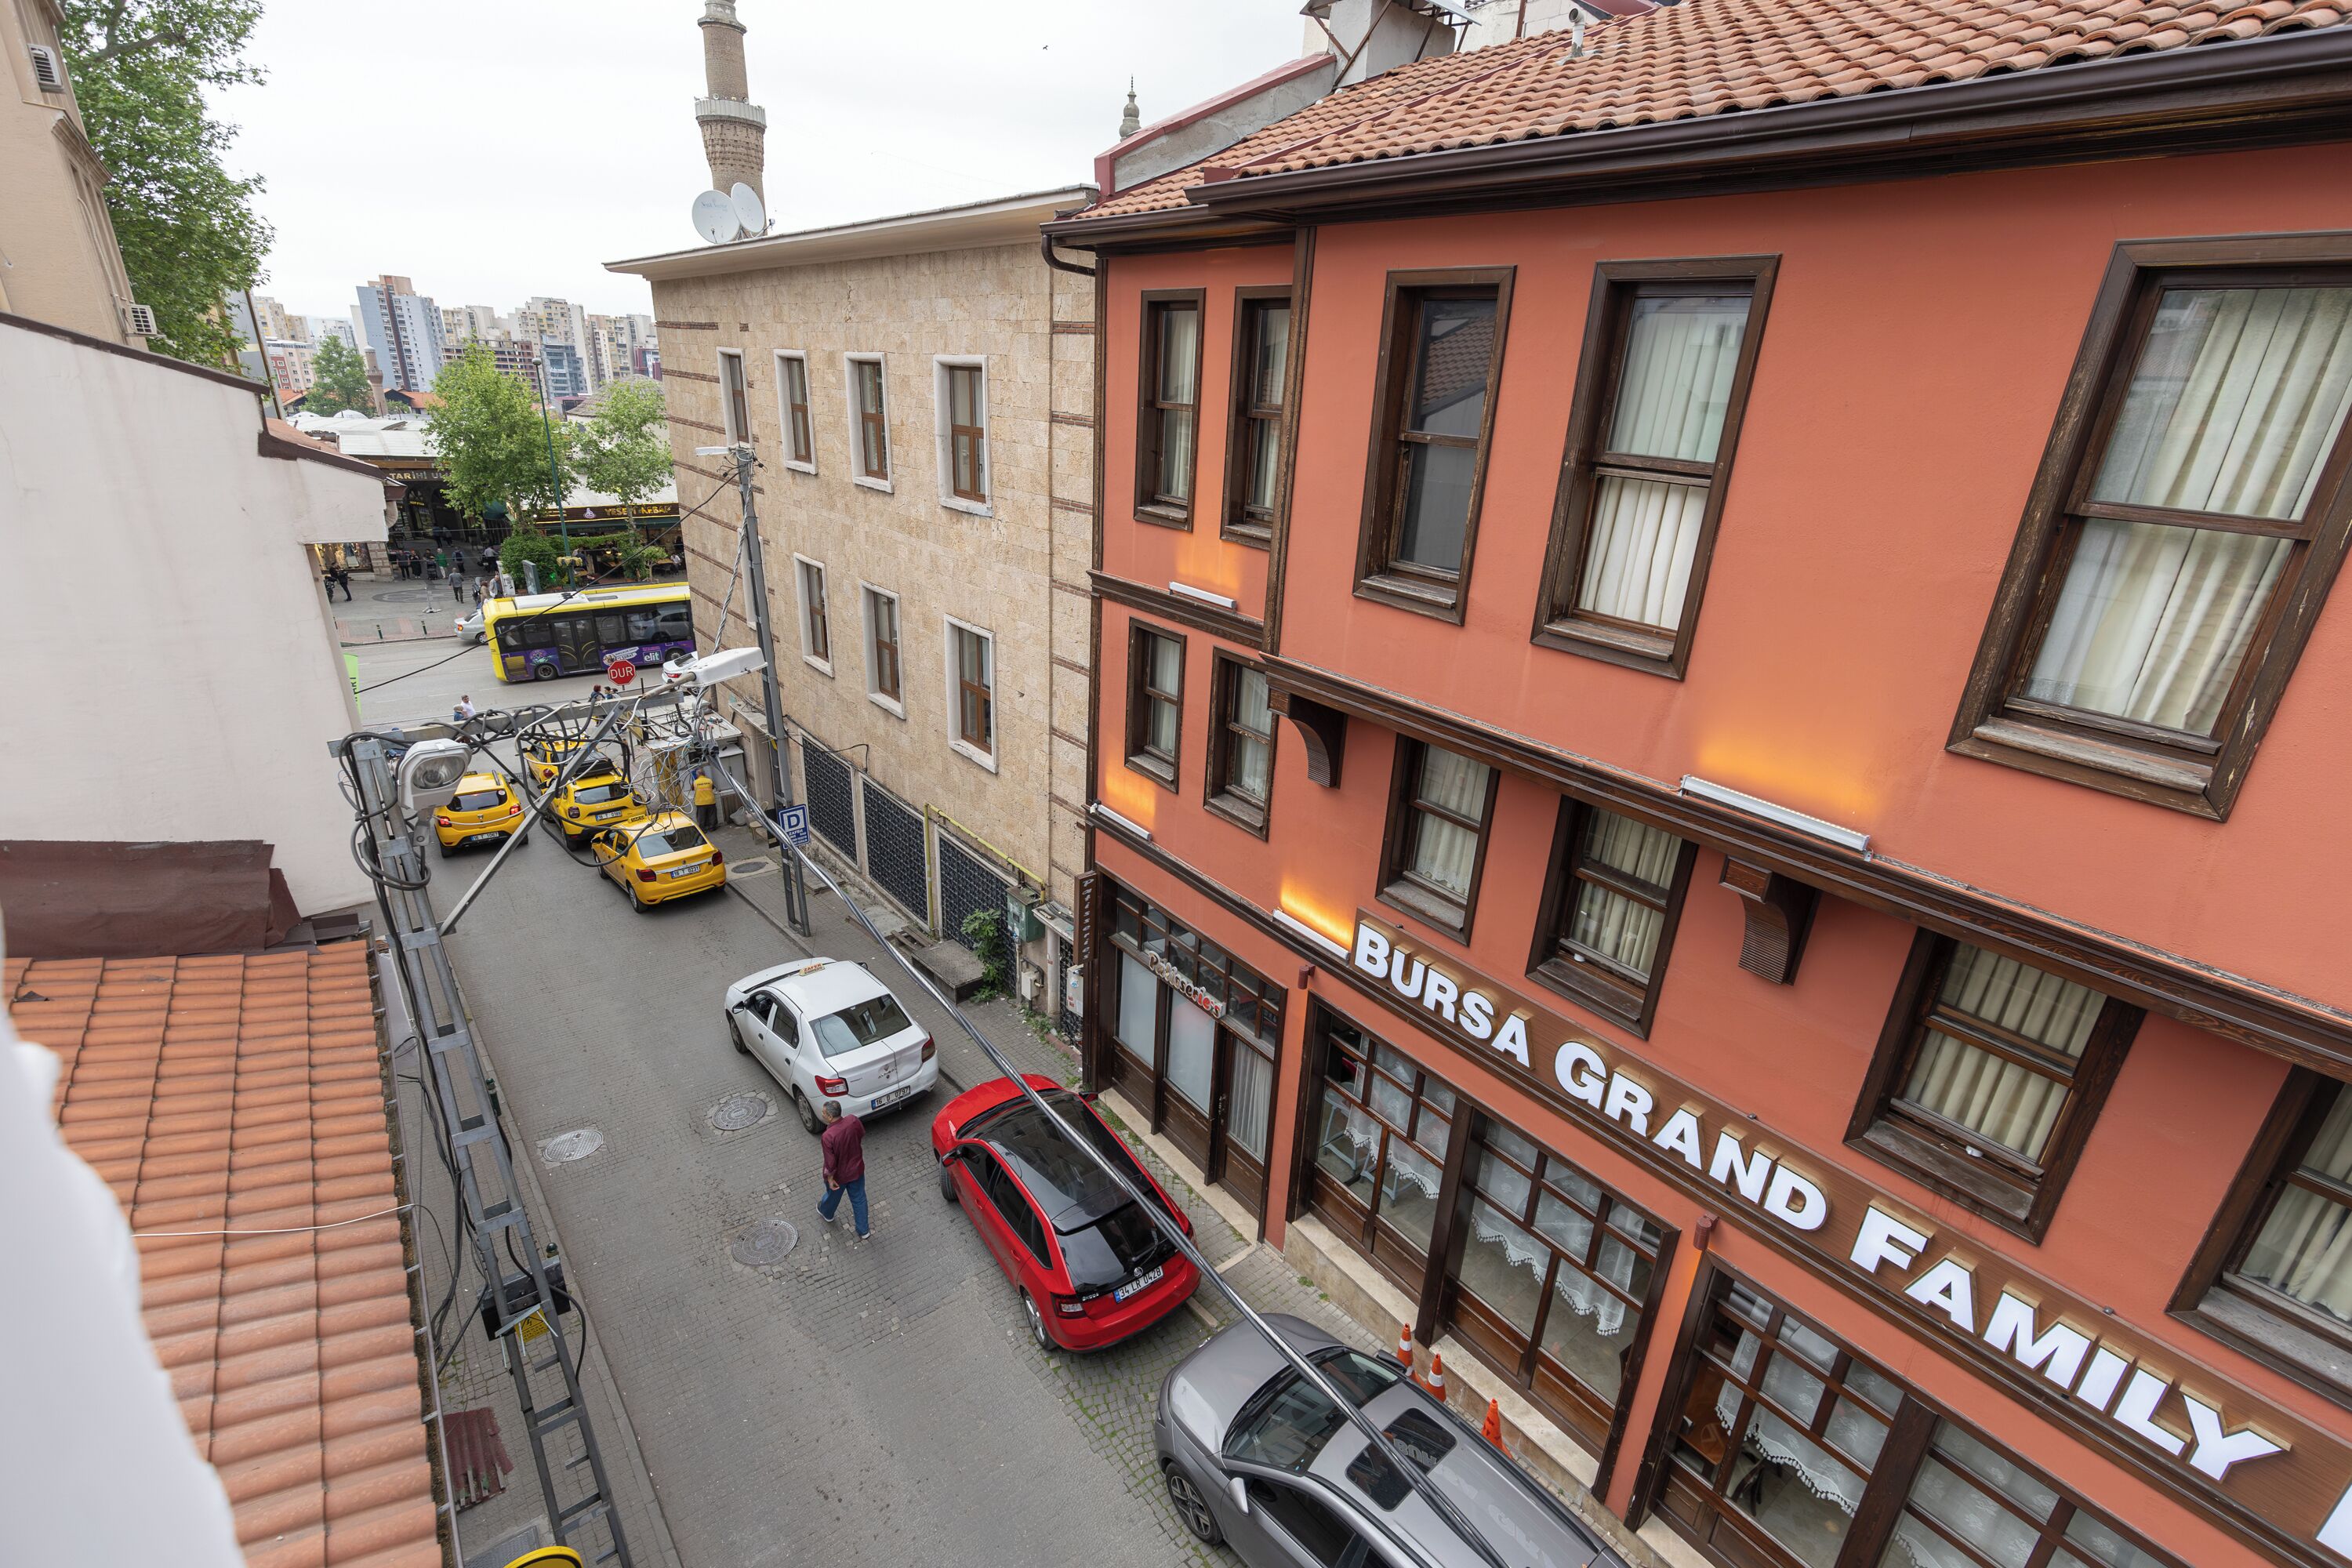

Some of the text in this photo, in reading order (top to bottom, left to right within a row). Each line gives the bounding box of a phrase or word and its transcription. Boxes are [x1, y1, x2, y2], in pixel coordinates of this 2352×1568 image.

[644, 652, 660, 662] elit
[611, 666, 633, 679] DUR
[787, 813, 800, 829] D
[1355, 921, 2285, 1481] BURSA GRAND FAMILY
[1120, 1269, 1162, 1298] 34 LR 0428
